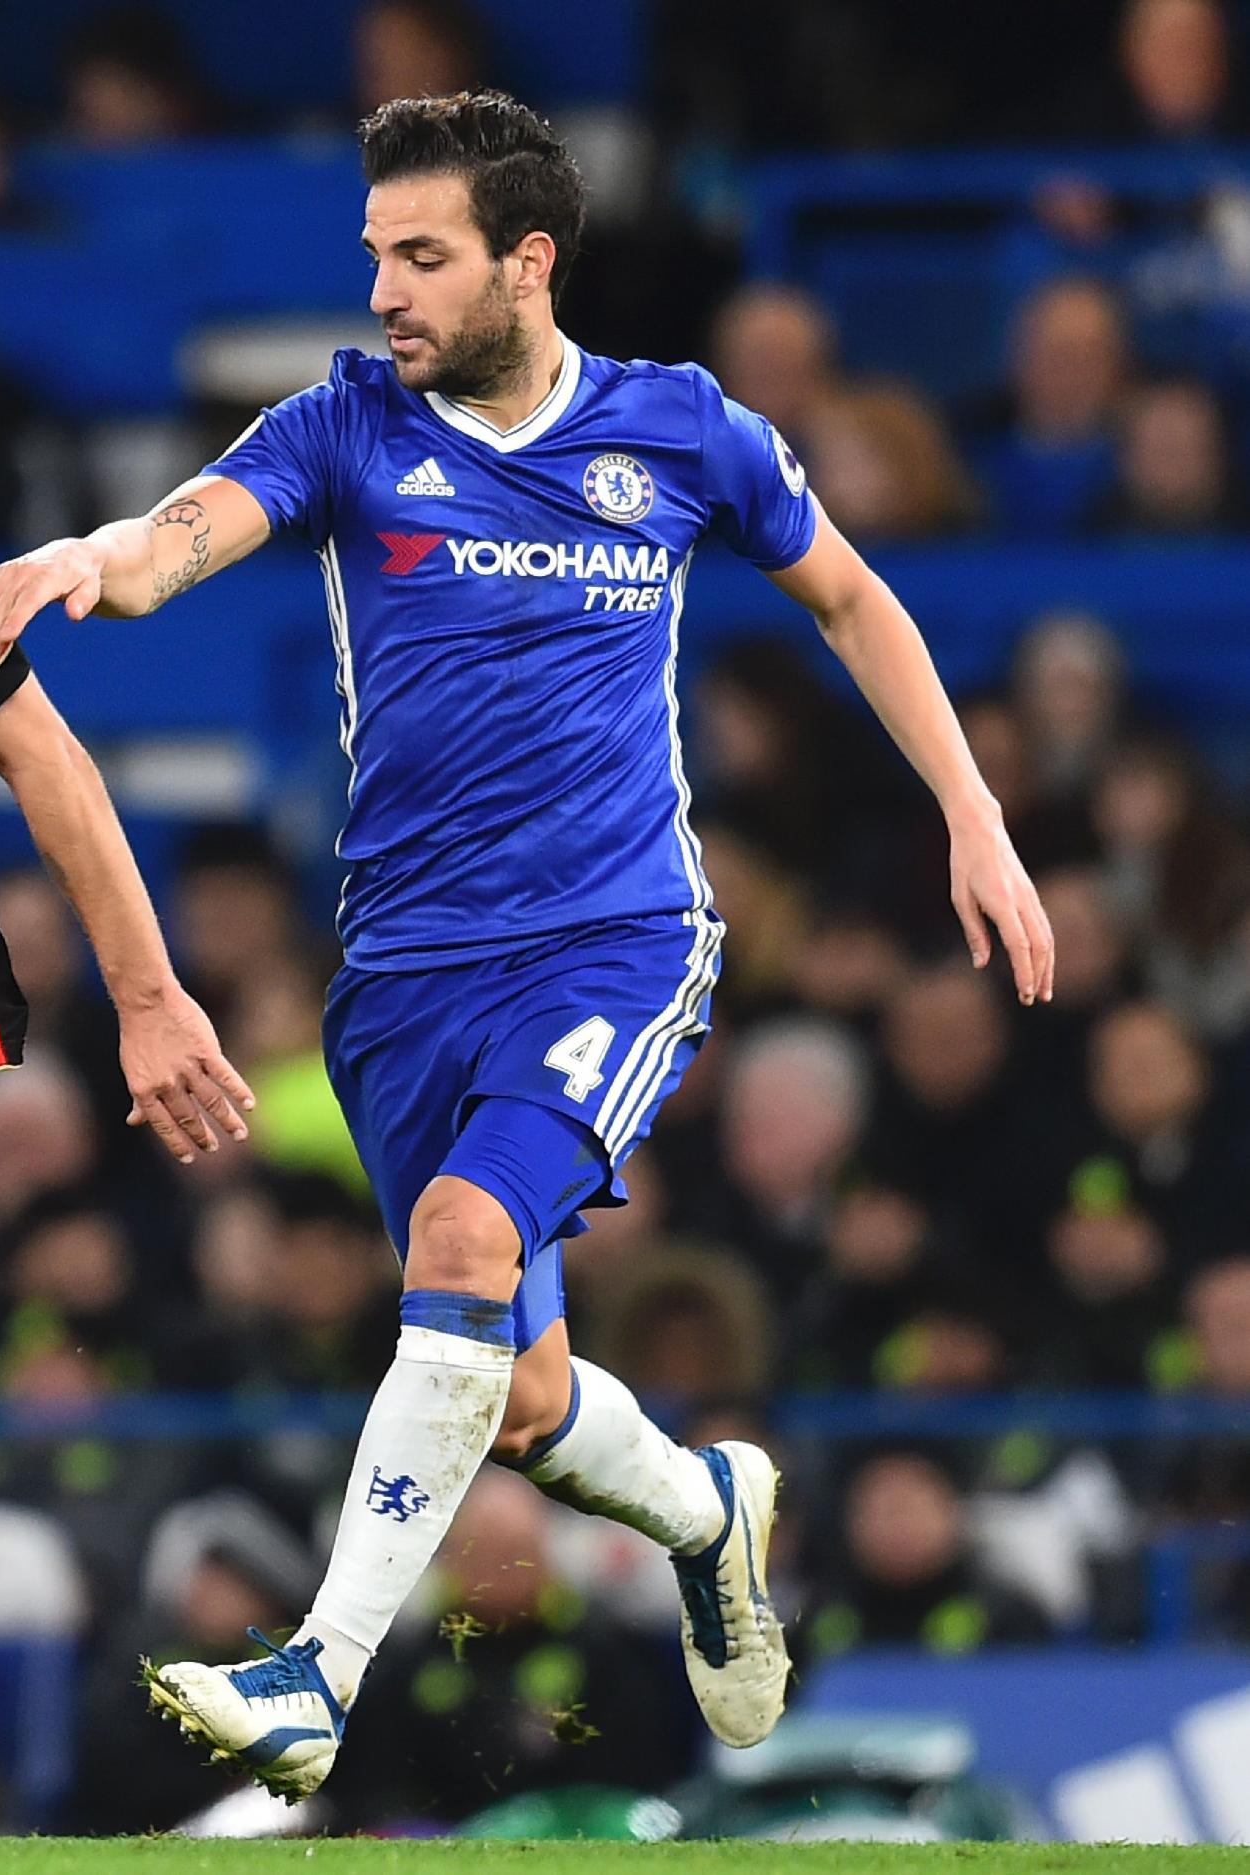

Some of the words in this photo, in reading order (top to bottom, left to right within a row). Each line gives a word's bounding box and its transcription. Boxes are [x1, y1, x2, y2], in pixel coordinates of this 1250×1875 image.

[591, 456, 635, 473] CHELSEA
[396, 481, 456, 497] adidas
[446, 539, 669, 582] YOKOHAMA
[583, 587, 664, 612] TYRES
[544, 1015, 616, 1104] 4
